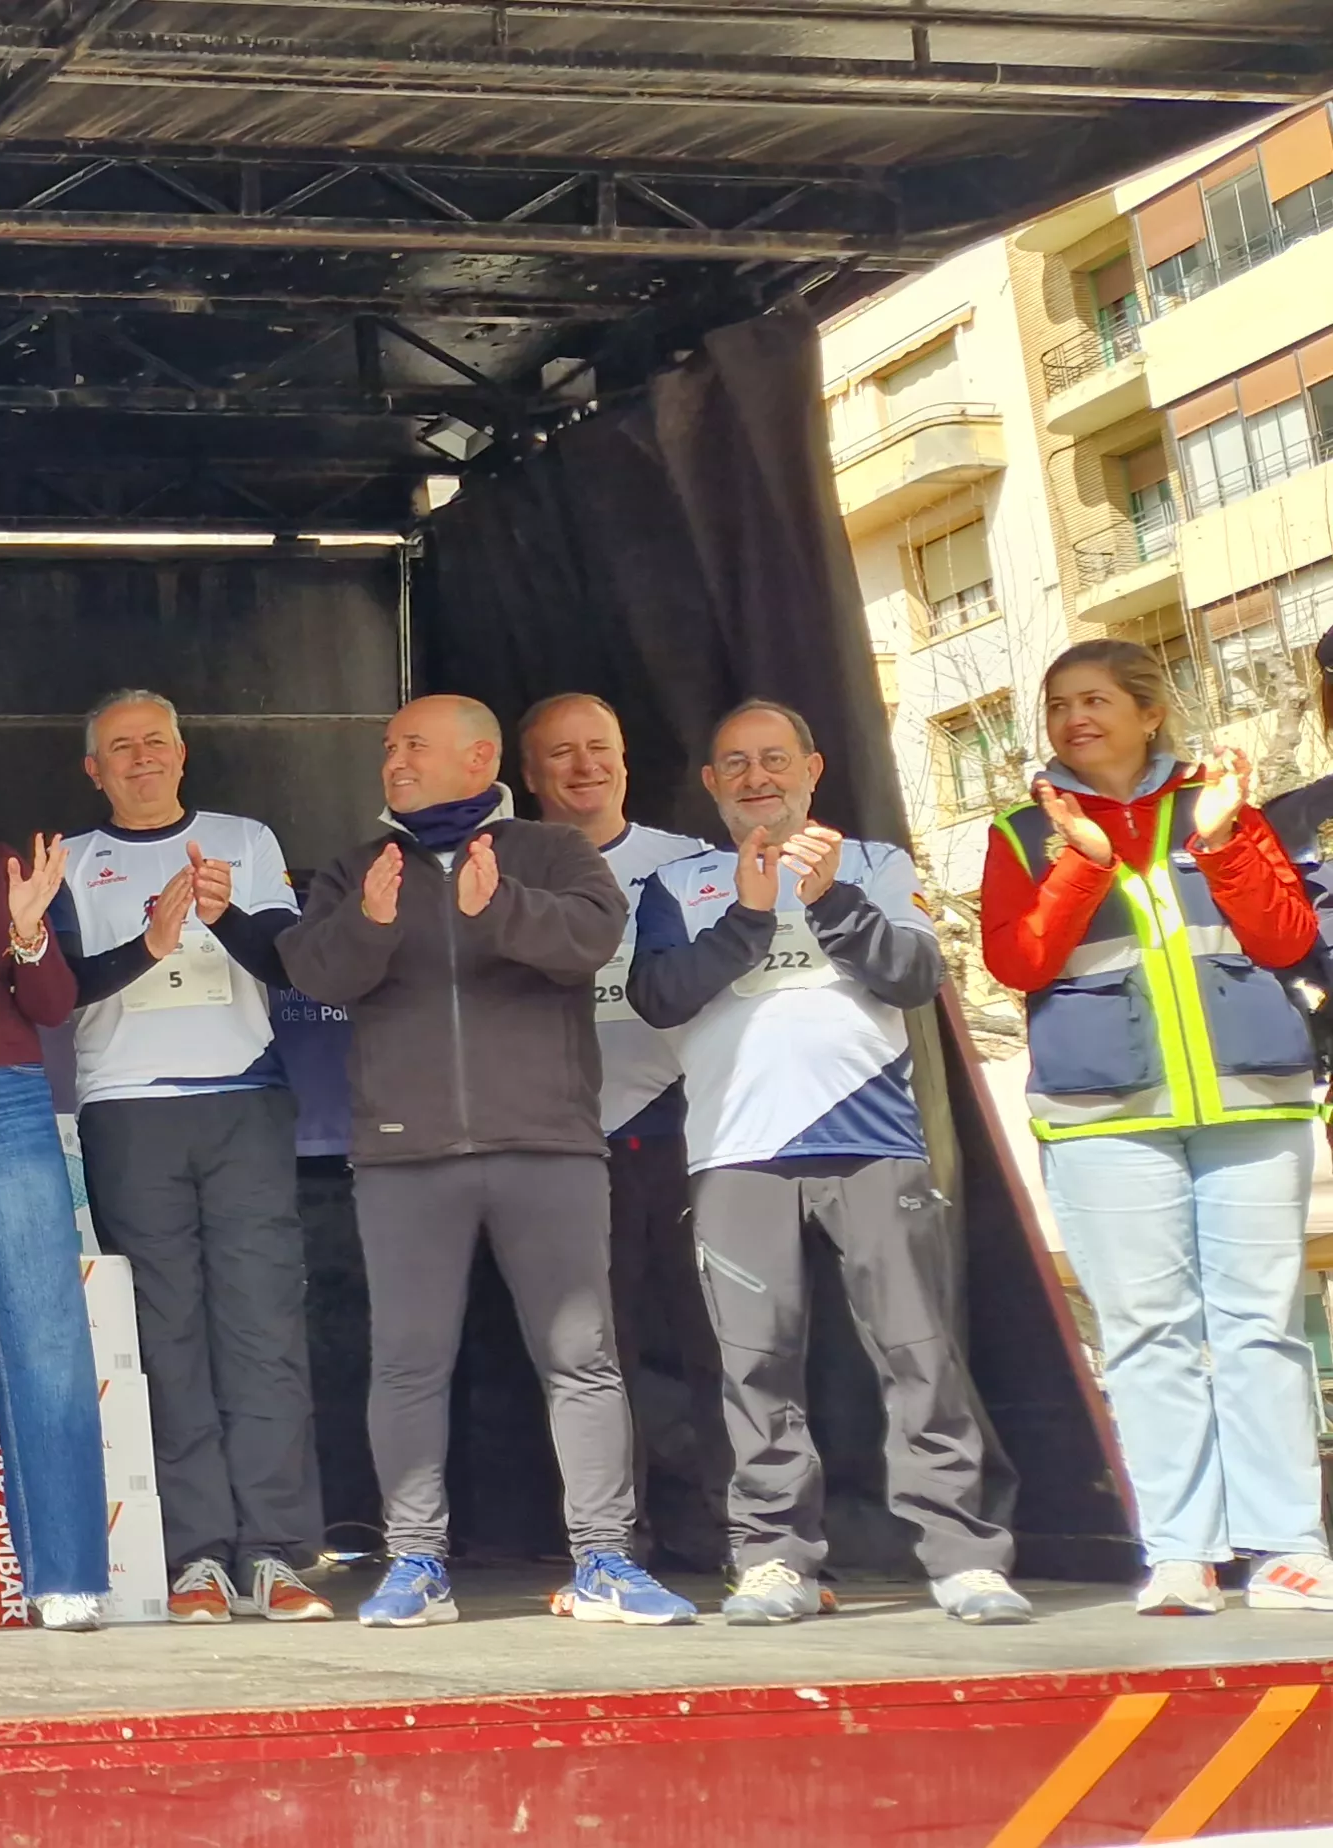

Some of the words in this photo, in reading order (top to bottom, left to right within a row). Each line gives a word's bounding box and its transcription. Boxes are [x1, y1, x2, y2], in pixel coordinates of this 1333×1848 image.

[86, 875, 128, 888] Santander
[763, 951, 813, 972] 222
[168, 971, 183, 989] 5
[281, 1005, 301, 1022] de
[304, 1005, 318, 1022] la
[320, 1005, 349, 1022] Pol
